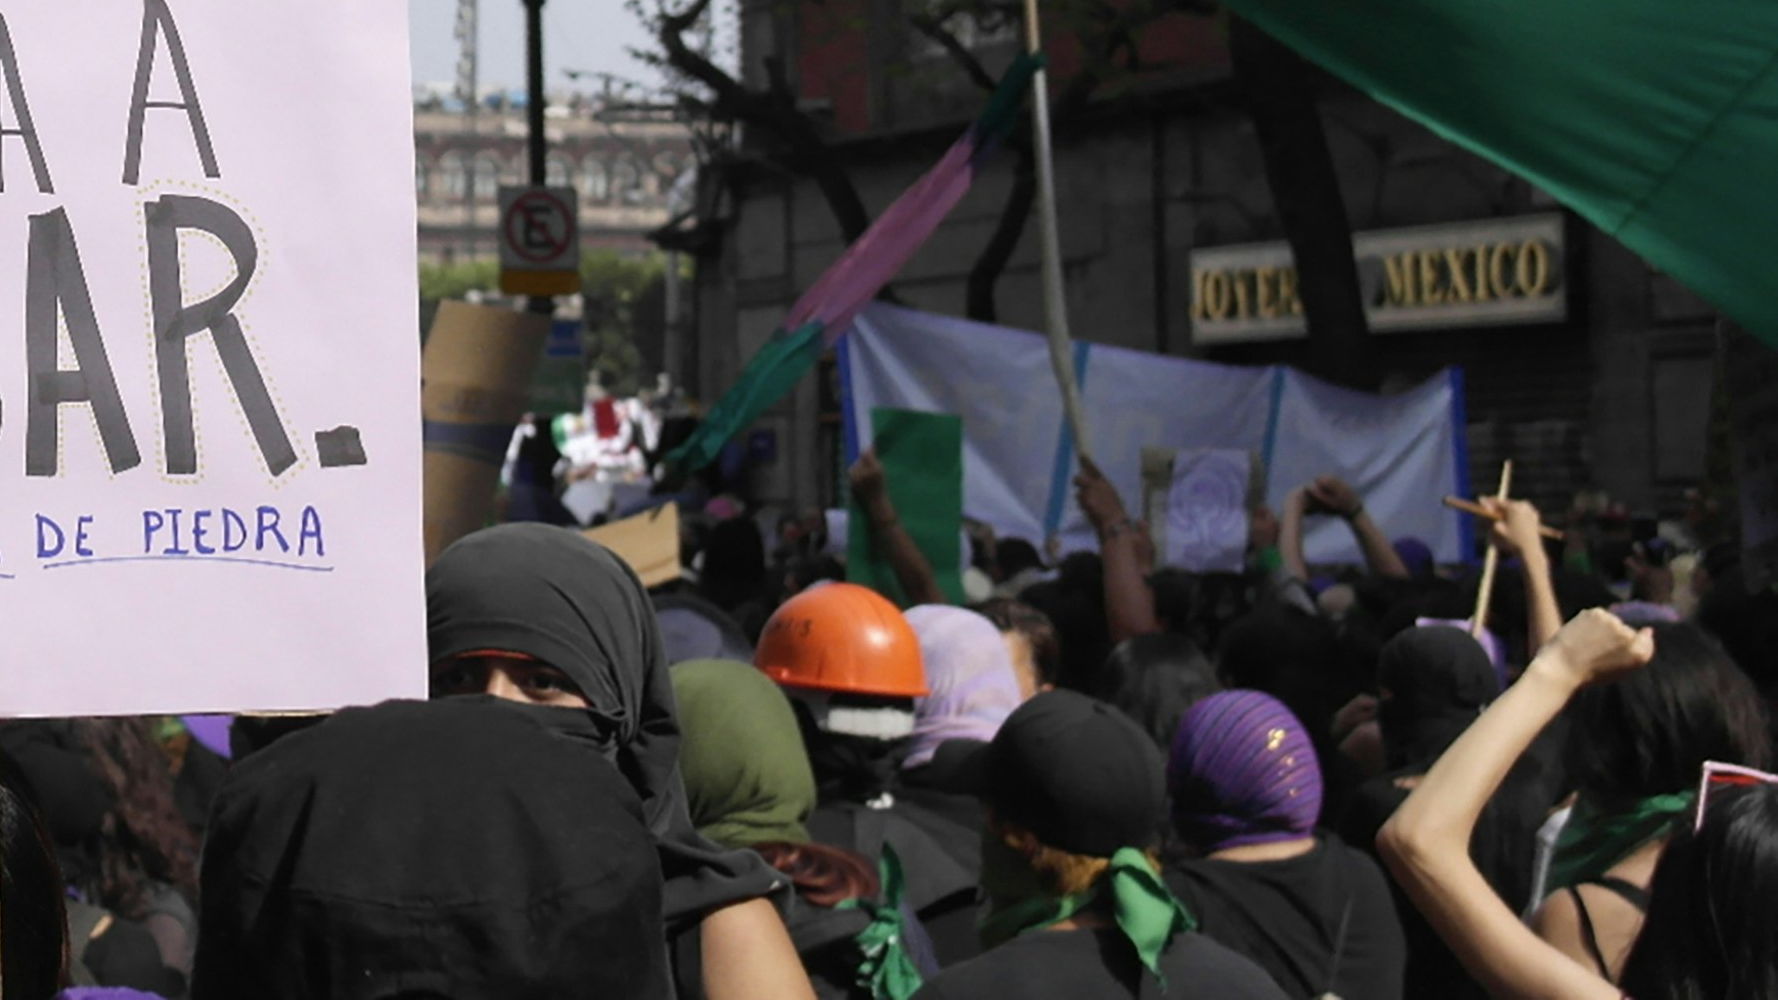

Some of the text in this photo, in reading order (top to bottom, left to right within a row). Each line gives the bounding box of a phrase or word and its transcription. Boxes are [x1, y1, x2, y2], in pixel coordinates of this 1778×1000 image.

[1190, 238, 1549, 322] JOYER MEXICO
[35, 513, 94, 559] DE
[143, 506, 325, 560] PIEDRA
